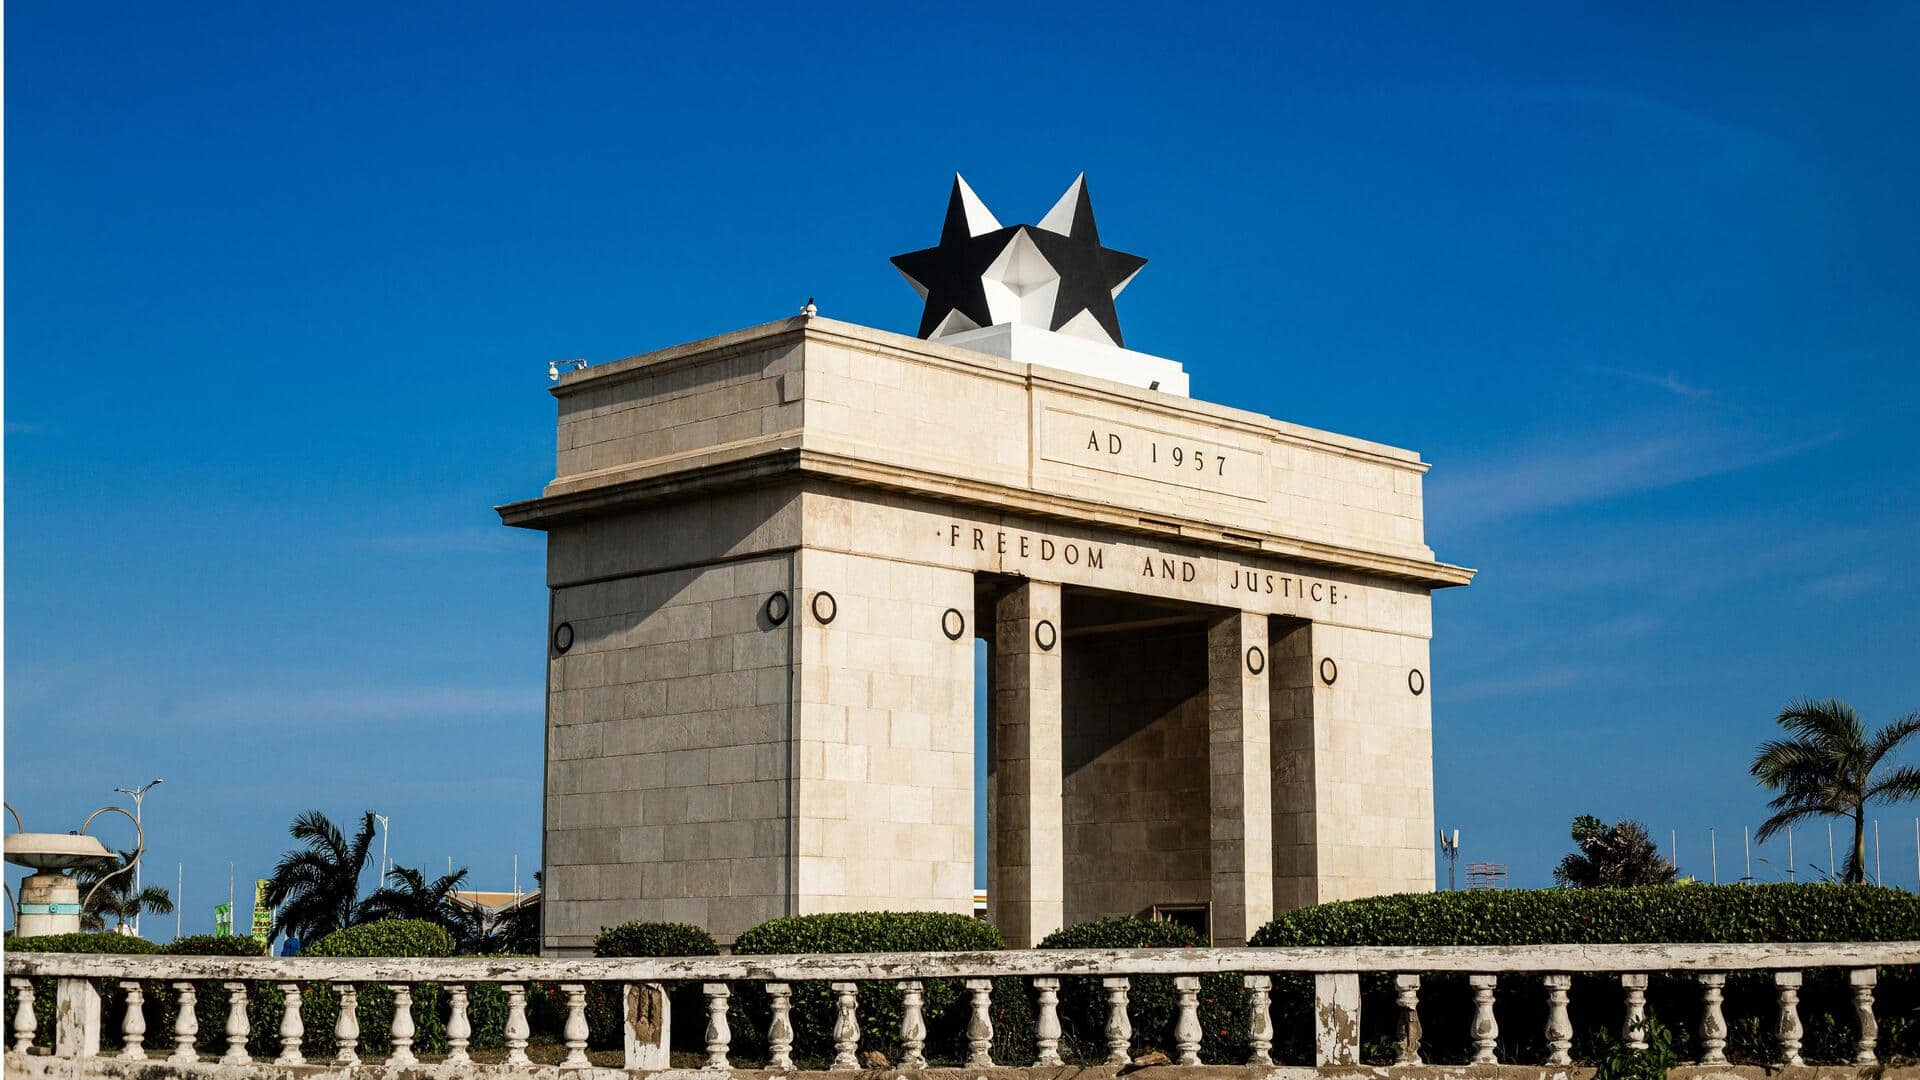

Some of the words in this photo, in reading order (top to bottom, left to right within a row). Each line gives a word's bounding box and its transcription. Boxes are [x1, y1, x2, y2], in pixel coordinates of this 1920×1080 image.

[1087, 429, 1123, 455] AD
[1151, 442, 1226, 476] 1957
[950, 524, 1104, 570] FREEDOM
[1142, 556, 1196, 583] AND
[1229, 569, 1338, 605] JUSTICE
